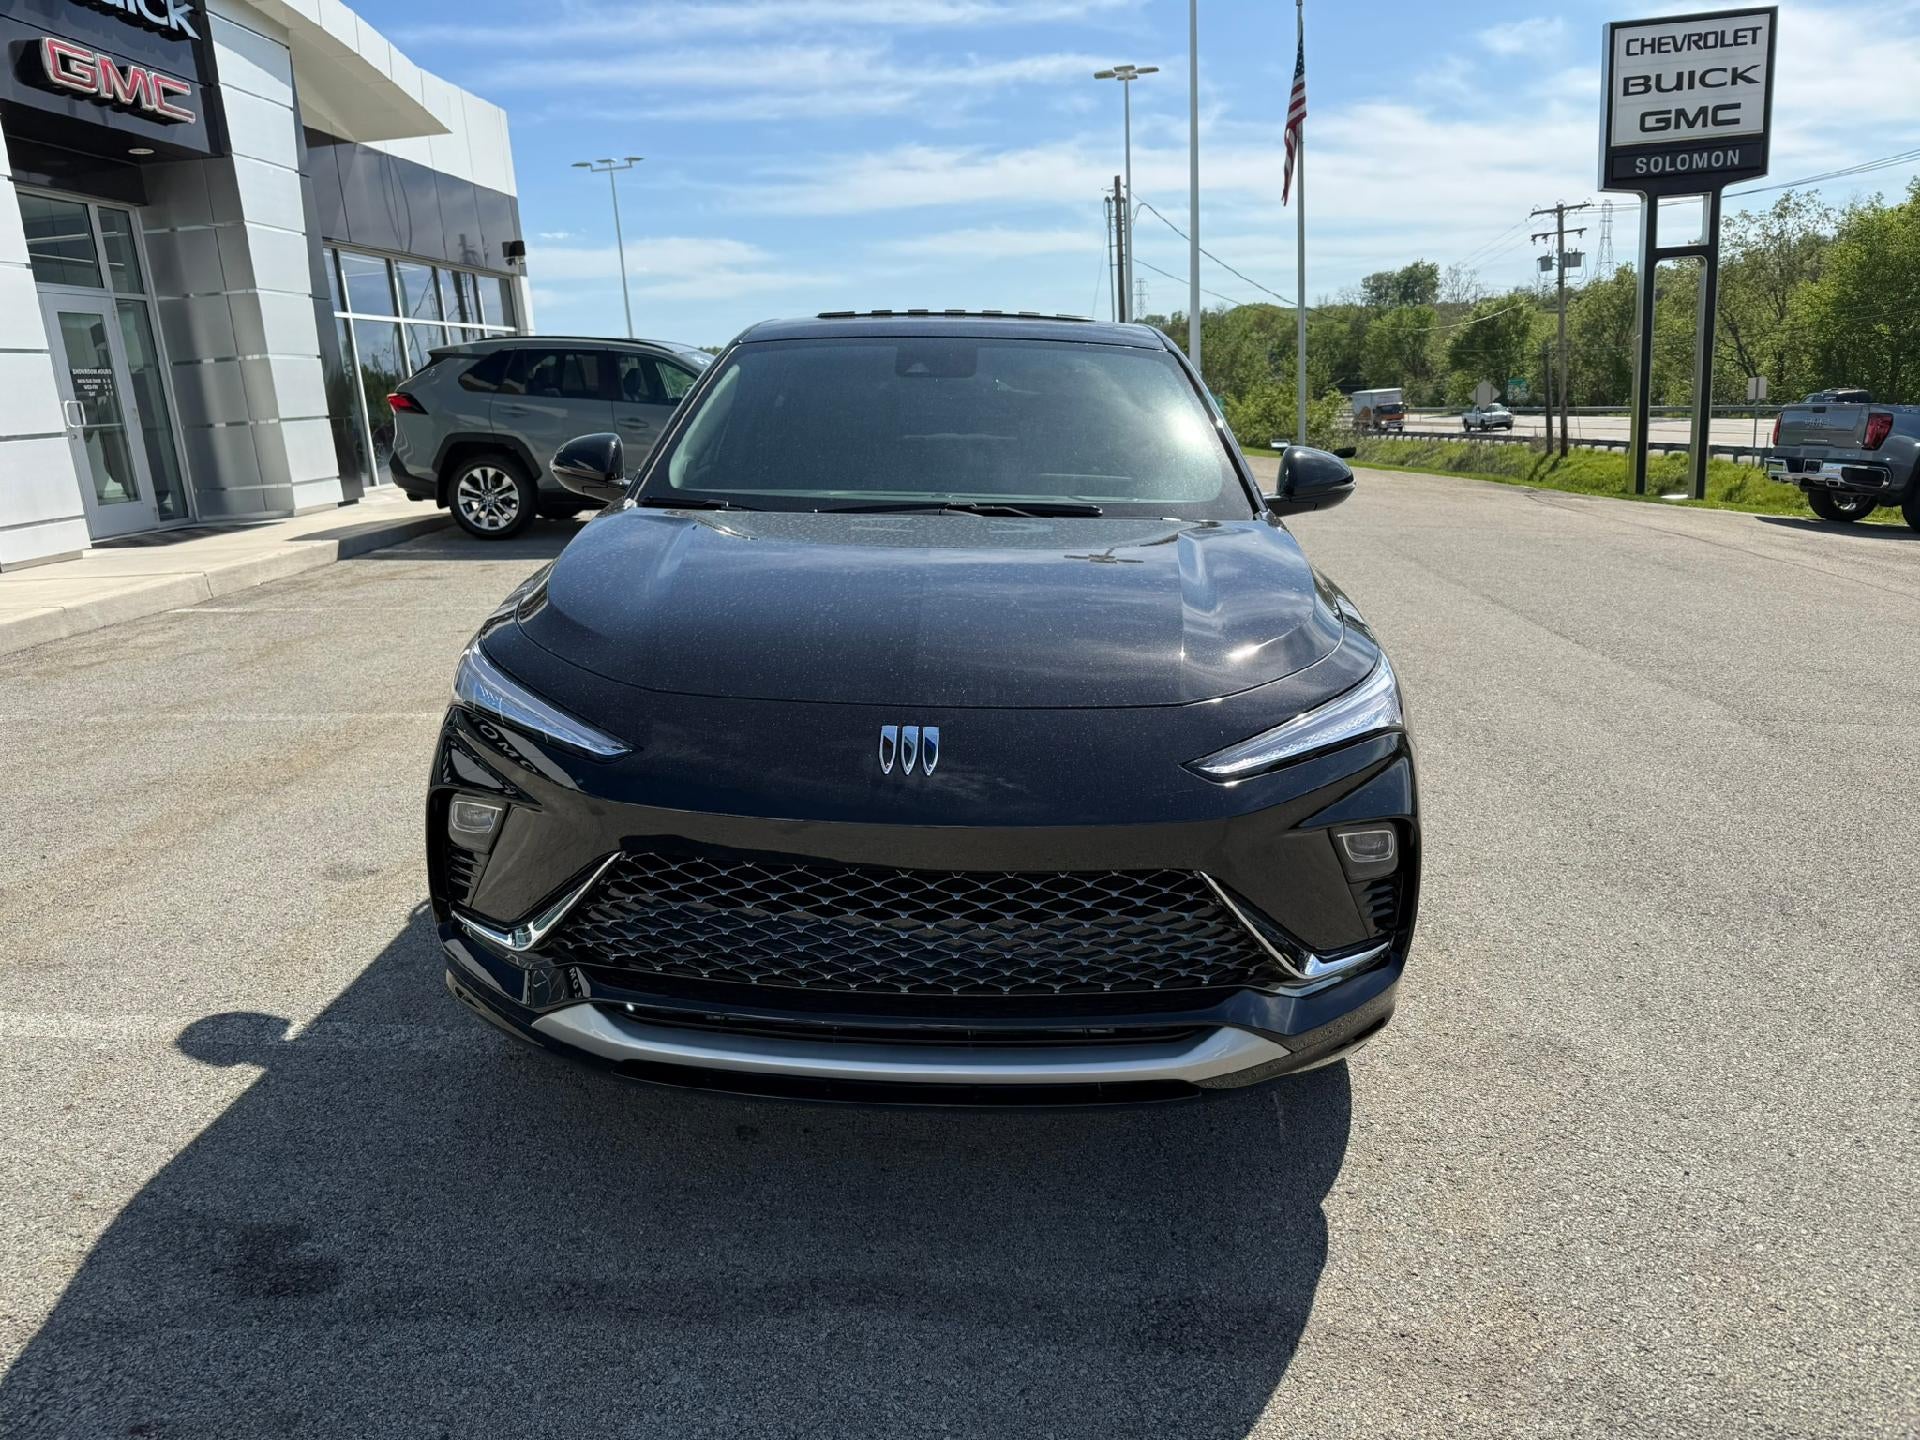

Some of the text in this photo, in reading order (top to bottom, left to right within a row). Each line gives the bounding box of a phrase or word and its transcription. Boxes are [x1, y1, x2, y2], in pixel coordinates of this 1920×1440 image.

[1625, 26, 1763, 57] CHEVROLET
[40, 36, 196, 124] GMC
[1622, 64, 1761, 97] BUICK
[1639, 102, 1742, 133] GMC
[1635, 149, 1740, 174] SOLOMON
